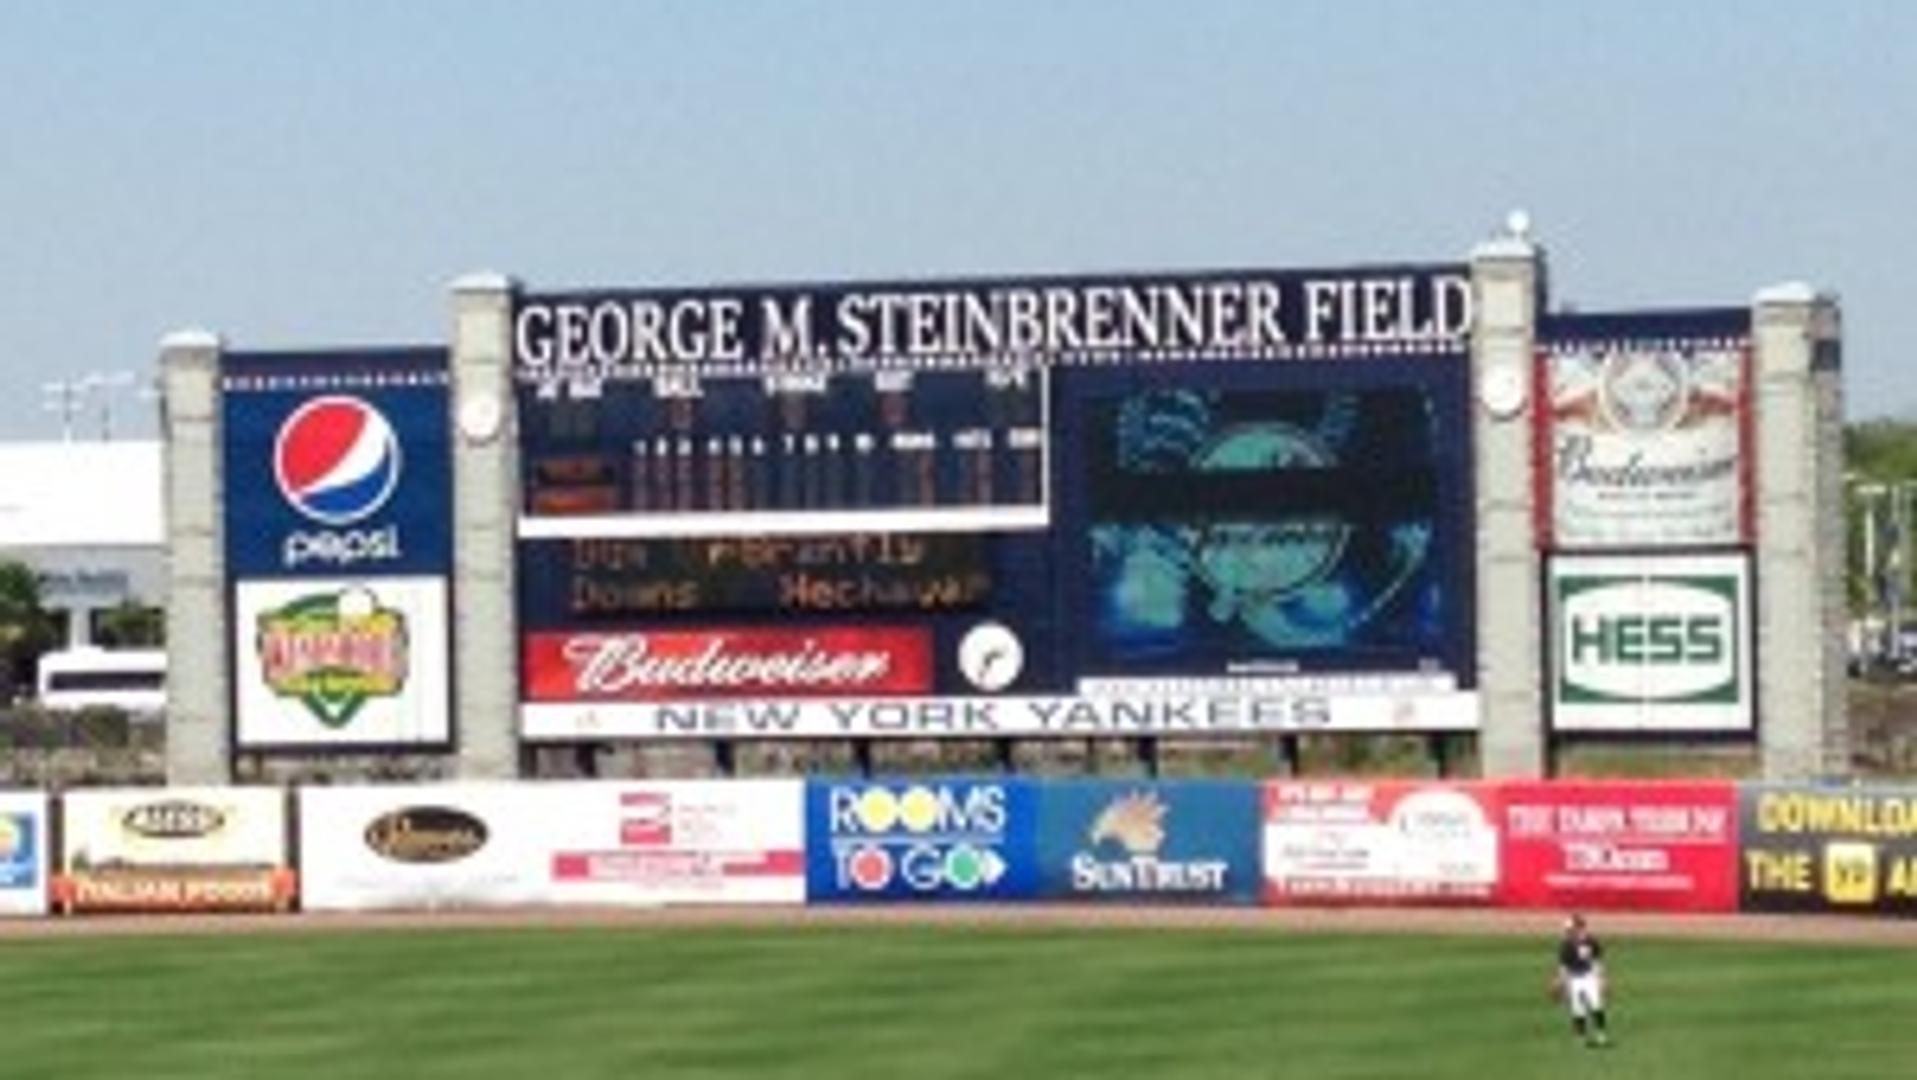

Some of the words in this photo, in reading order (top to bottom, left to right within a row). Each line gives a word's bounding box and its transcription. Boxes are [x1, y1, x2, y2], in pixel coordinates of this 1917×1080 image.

[516, 299, 744, 370] GEORGE
[763, 296, 829, 357] M.
[837, 280, 1285, 355] STEINBRENNER
[1303, 274, 1472, 341] FIELD
[283, 525, 400, 567] pepsi
[562, 632, 890, 693] Budweiser
[1572, 614, 1723, 666] HESS
[655, 703, 801, 731] NEW
[830, 701, 1000, 730] YORK
[1030, 697, 1332, 729] YANKEES
[831, 785, 1005, 834] ROOMS
[1757, 791, 1917, 836] DOWNLO
[831, 844, 893, 891] TO
[903, 844, 983, 891] GO
[1745, 850, 1812, 891] THE
